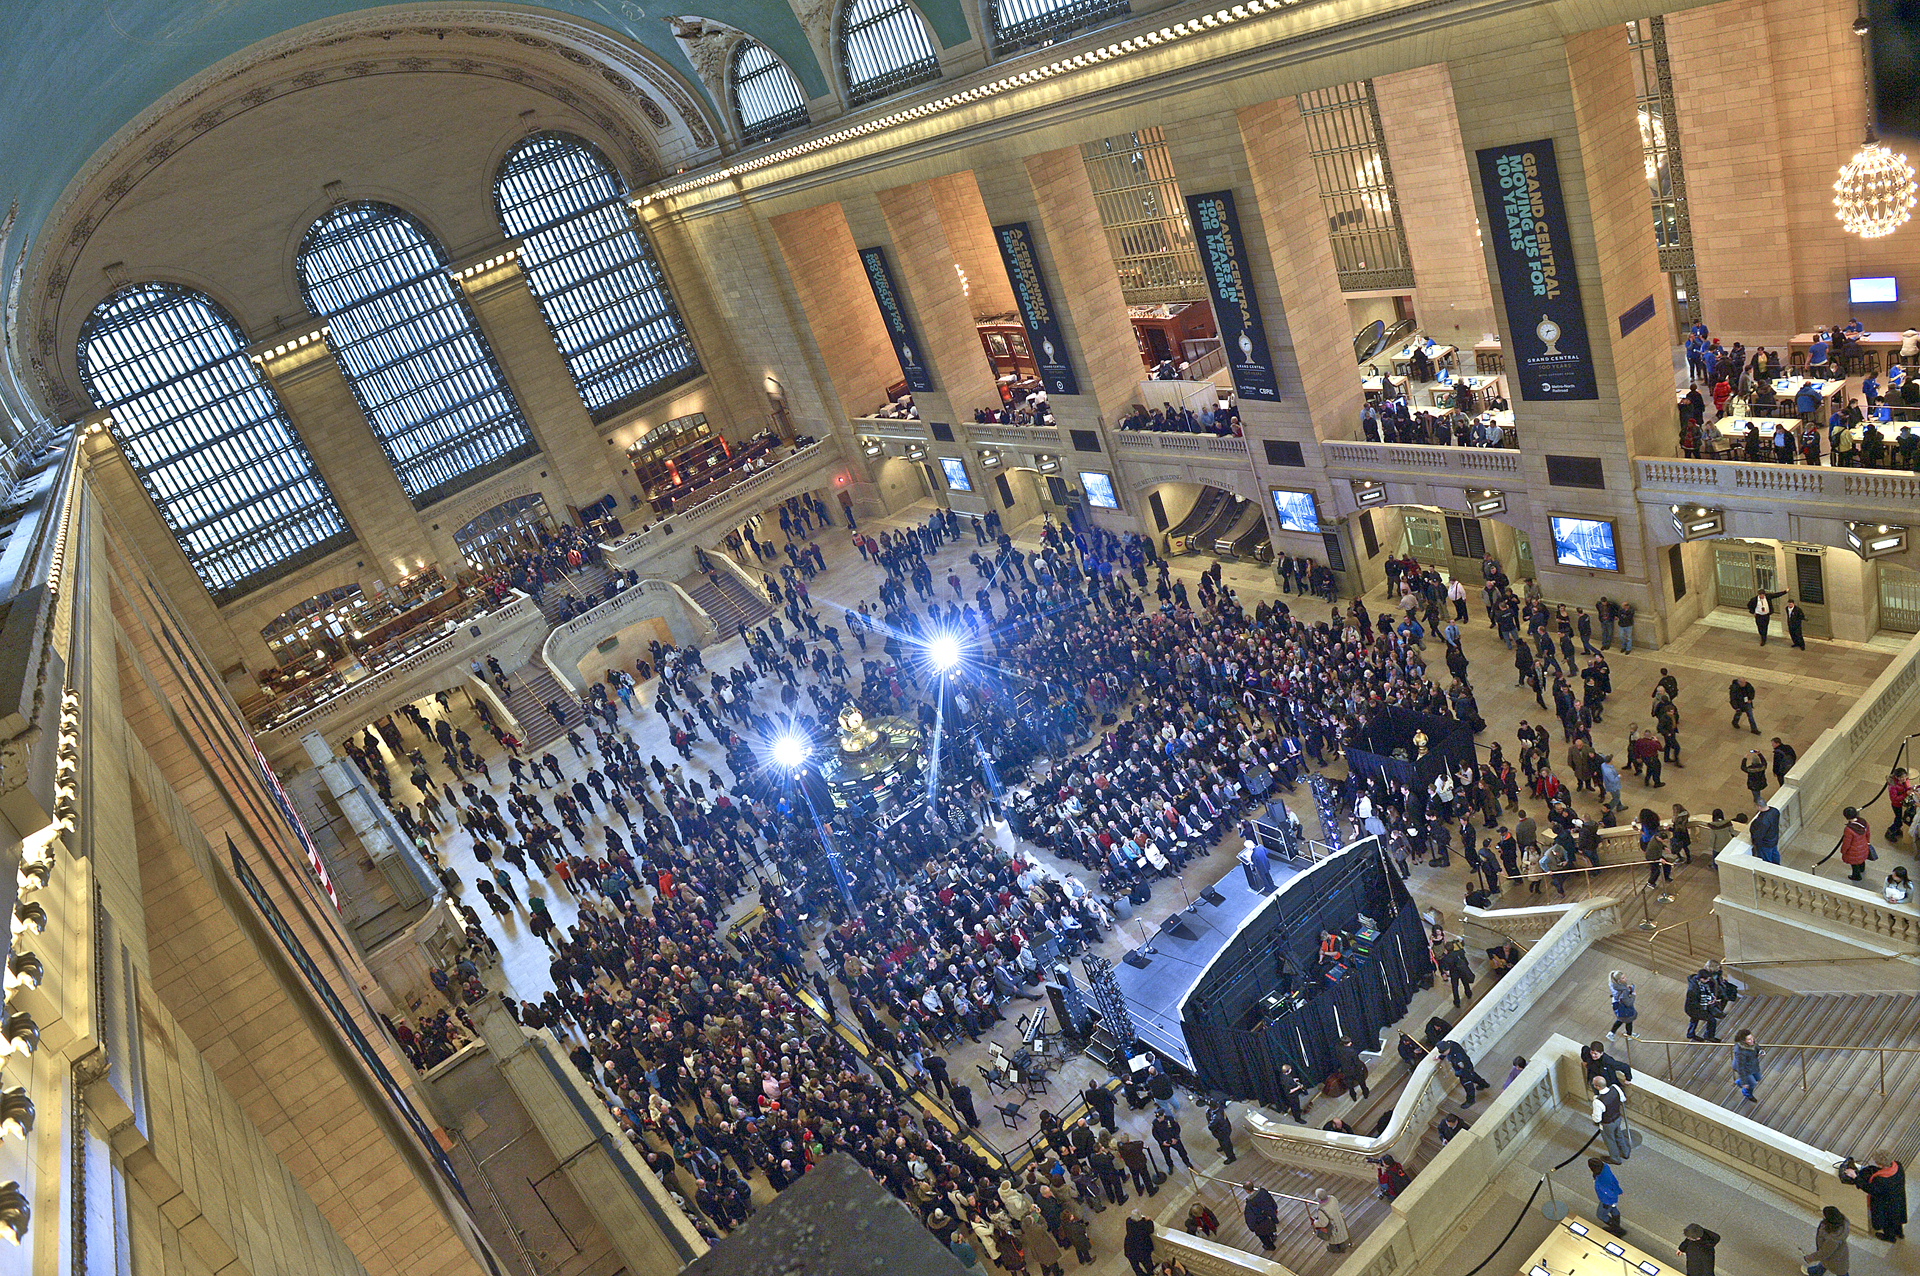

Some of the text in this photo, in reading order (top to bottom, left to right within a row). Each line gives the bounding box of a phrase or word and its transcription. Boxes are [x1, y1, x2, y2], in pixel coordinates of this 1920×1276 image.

[1496, 155, 1525, 250] 100 YEARS
[1509, 155, 1546, 296] MOVING US FOR
[1522, 153, 1560, 299] GRAND CENTRAL
[869, 254, 888, 296] MOVING
[891, 312, 902, 332] FOR
[873, 253, 906, 334] GRAND CENTRAL
[1002, 231, 1039, 330] ISN'T IT GRAND
[1009, 230, 1042, 321] CELEBRATION
[1015, 229, 1050, 324] A CENTENNIAL
[1198, 200, 1228, 299] THE MAKING
[1206, 199, 1239, 303] 100 YEARS IN
[1215, 199, 1252, 329] GRAND CENTRAL
[503, 483, 527, 494] AVENUE
[720, 524, 734, 538] TICKET
[1212, 481, 1235, 490] STREET
[348, 716, 374, 733] SHUTTLE
[409, 688, 432, 701] STREET
